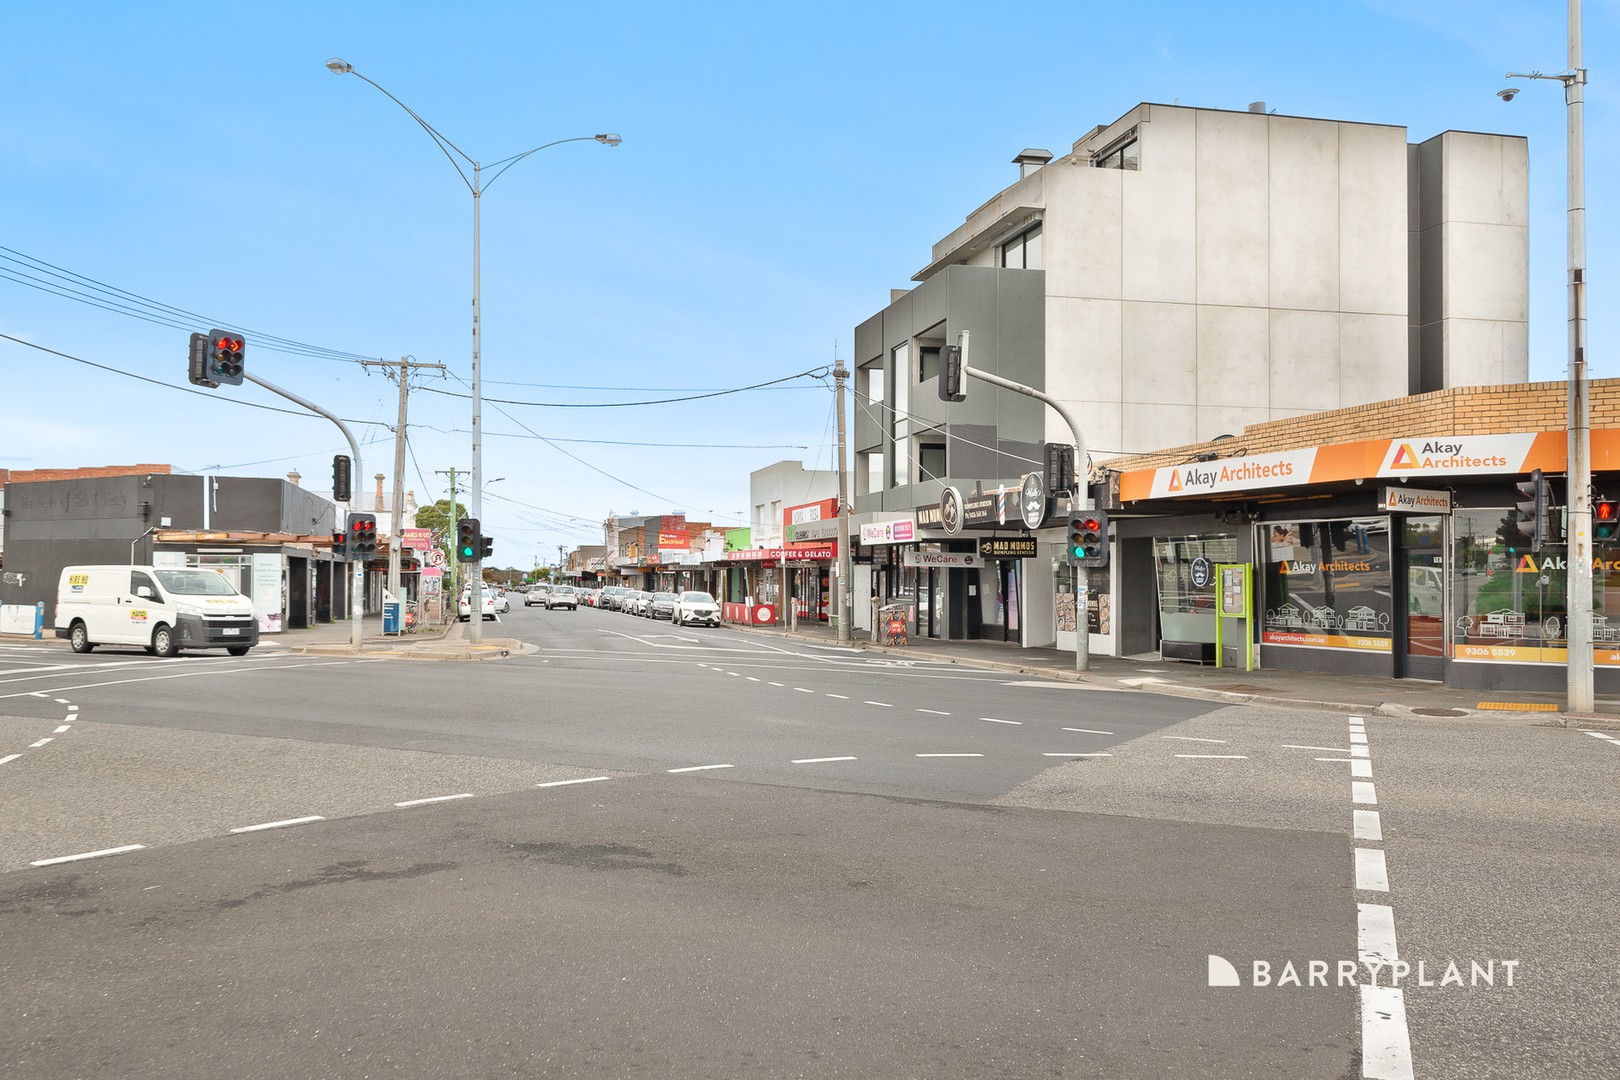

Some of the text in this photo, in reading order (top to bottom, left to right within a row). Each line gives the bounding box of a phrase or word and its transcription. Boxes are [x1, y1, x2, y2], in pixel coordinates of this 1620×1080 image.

[1422, 441, 1463, 456] Akay
[1421, 454, 1507, 469] Architects
[1185, 460, 1293, 488] Akay Architects
[1397, 492, 1448, 508] Akay Architects
[918, 509, 929, 525] MAD
[659, 533, 684, 545] Electrical
[866, 527, 884, 539] WeCare
[993, 541, 1035, 550] MAD MOMOS
[770, 550, 796, 558] COFEE
[804, 550, 832, 558] GELATO
[923, 554, 957, 563] WeCare
[1292, 560, 1370, 574] Akay Architects
[1541, 556, 1567, 570] Ak
[1269, 633, 1325, 643] akayarchitects.com.au
[1357, 638, 1388, 647] 9306 5539
[1465, 647, 1516, 657] 9306 5539
